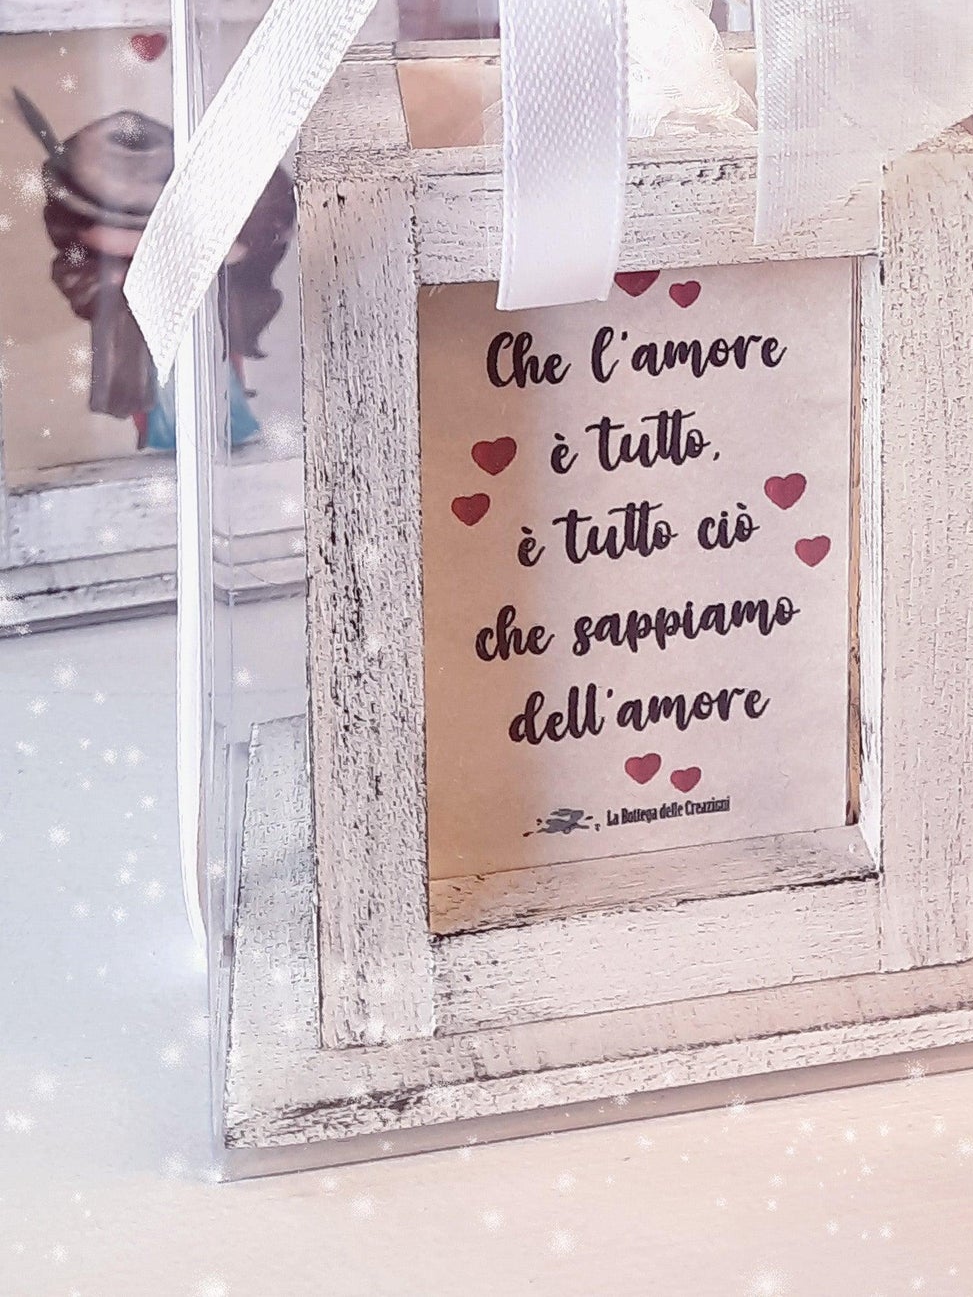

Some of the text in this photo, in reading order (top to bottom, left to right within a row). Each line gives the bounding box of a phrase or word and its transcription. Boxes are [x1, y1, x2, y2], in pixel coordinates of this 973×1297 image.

[487, 326, 787, 389] Che l'amore
[550, 408, 721, 475] è tutto,
[517, 500, 760, 568] è tutto ciò
[474, 596, 801, 662] che sappiamo
[508, 682, 771, 746] dell'amore
[607, 795, 730, 826] La Bottega delle Creazioni
